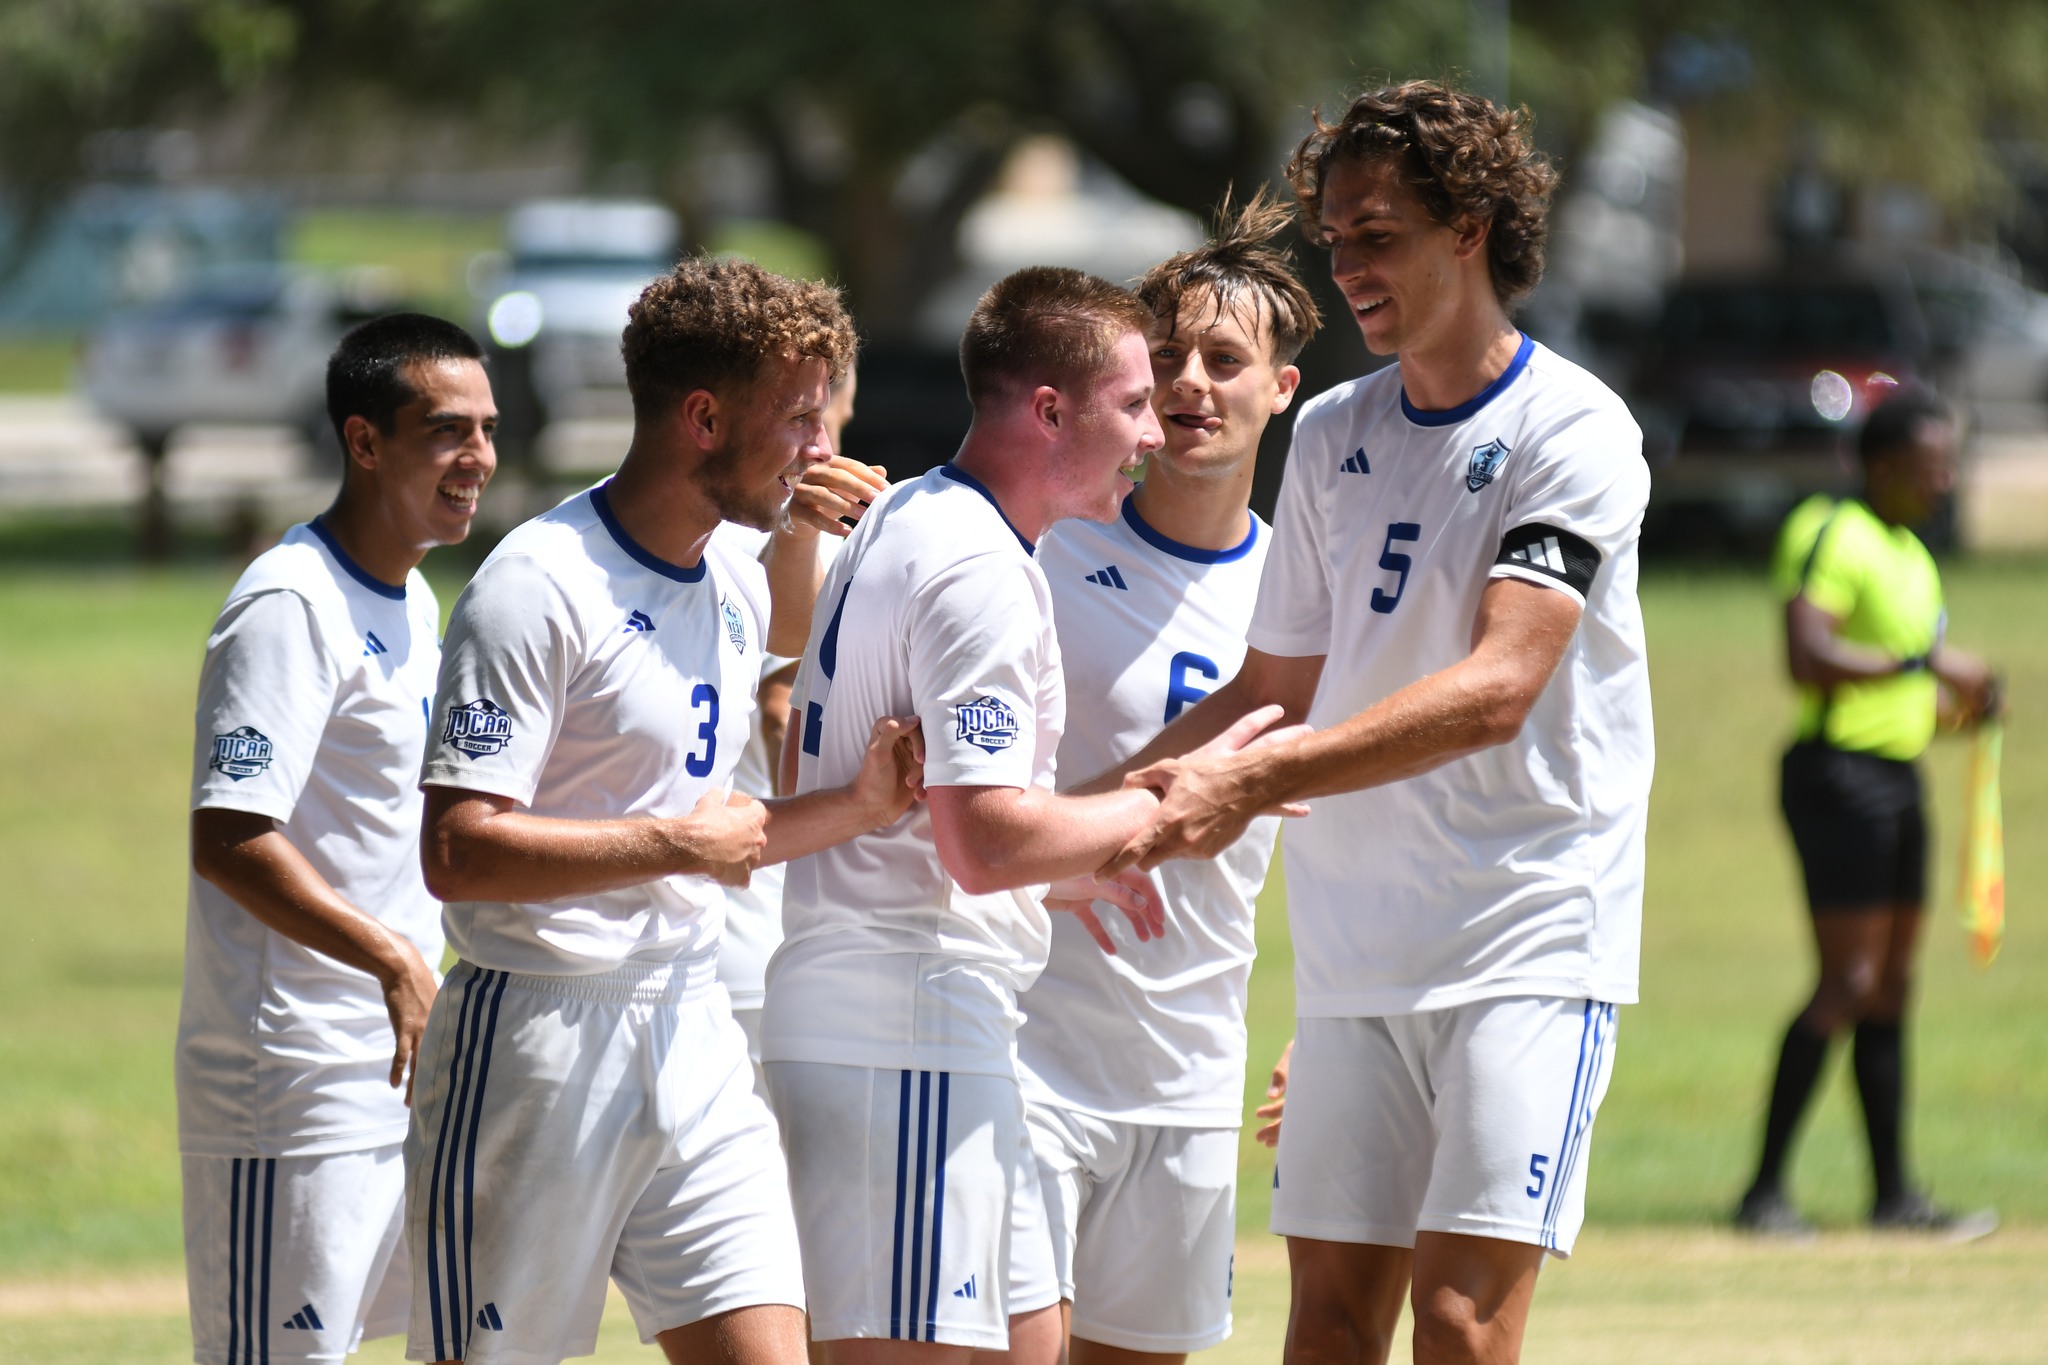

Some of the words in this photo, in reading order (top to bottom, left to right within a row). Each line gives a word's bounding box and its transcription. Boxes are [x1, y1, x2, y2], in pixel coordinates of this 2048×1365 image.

[1370, 522, 1421, 614] 5
[446, 710, 509, 739] NJCAA
[685, 684, 719, 778] 3
[960, 707, 1015, 735] NJCAA
[213, 738, 269, 763] NJCAA
[463, 740, 492, 752] SOCCER
[1526, 1153, 1549, 1199] 5
